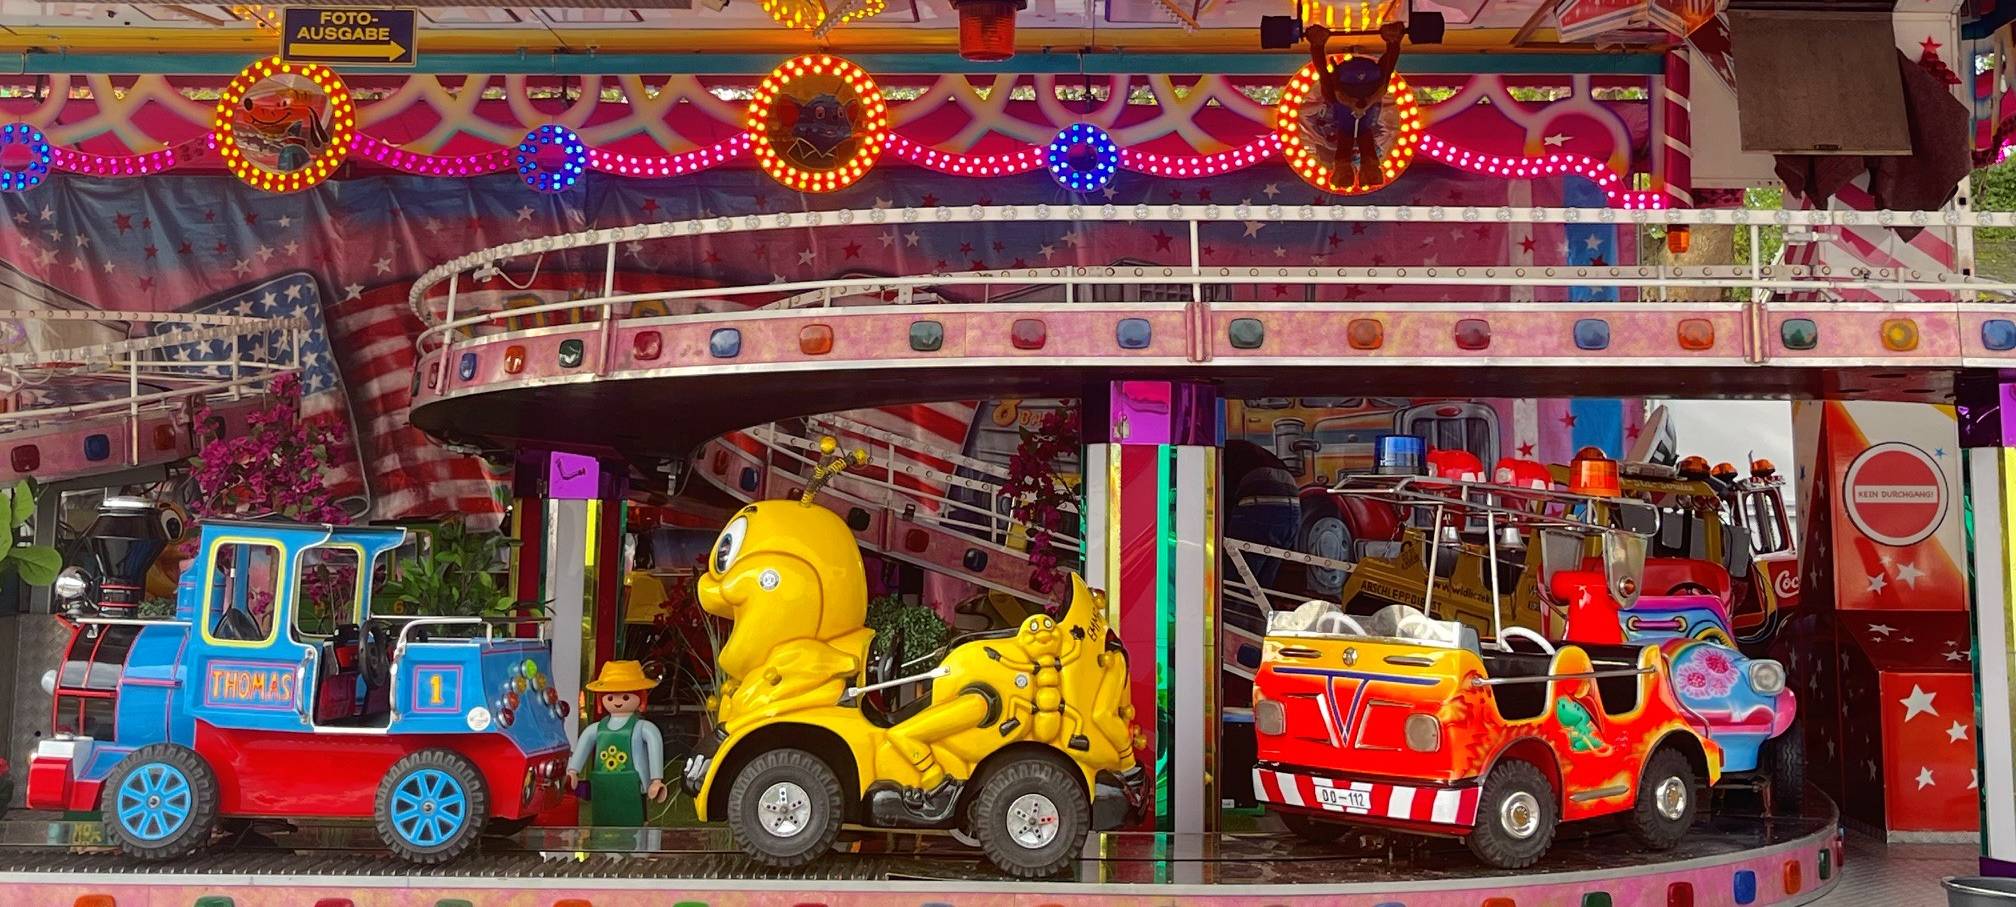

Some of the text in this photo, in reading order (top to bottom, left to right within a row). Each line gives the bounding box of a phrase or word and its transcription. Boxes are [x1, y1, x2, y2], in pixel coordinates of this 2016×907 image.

[320, 11, 379, 25] FOTO-
[297, 27, 391, 41] AUSGABE
[1858, 490, 1934, 499] KEIN DURCHGANG!
[1361, 580, 1442, 612] ABSCHLEPPDIEST
[211, 670, 293, 700] THOMAS
[430, 674, 445, 704] 1
